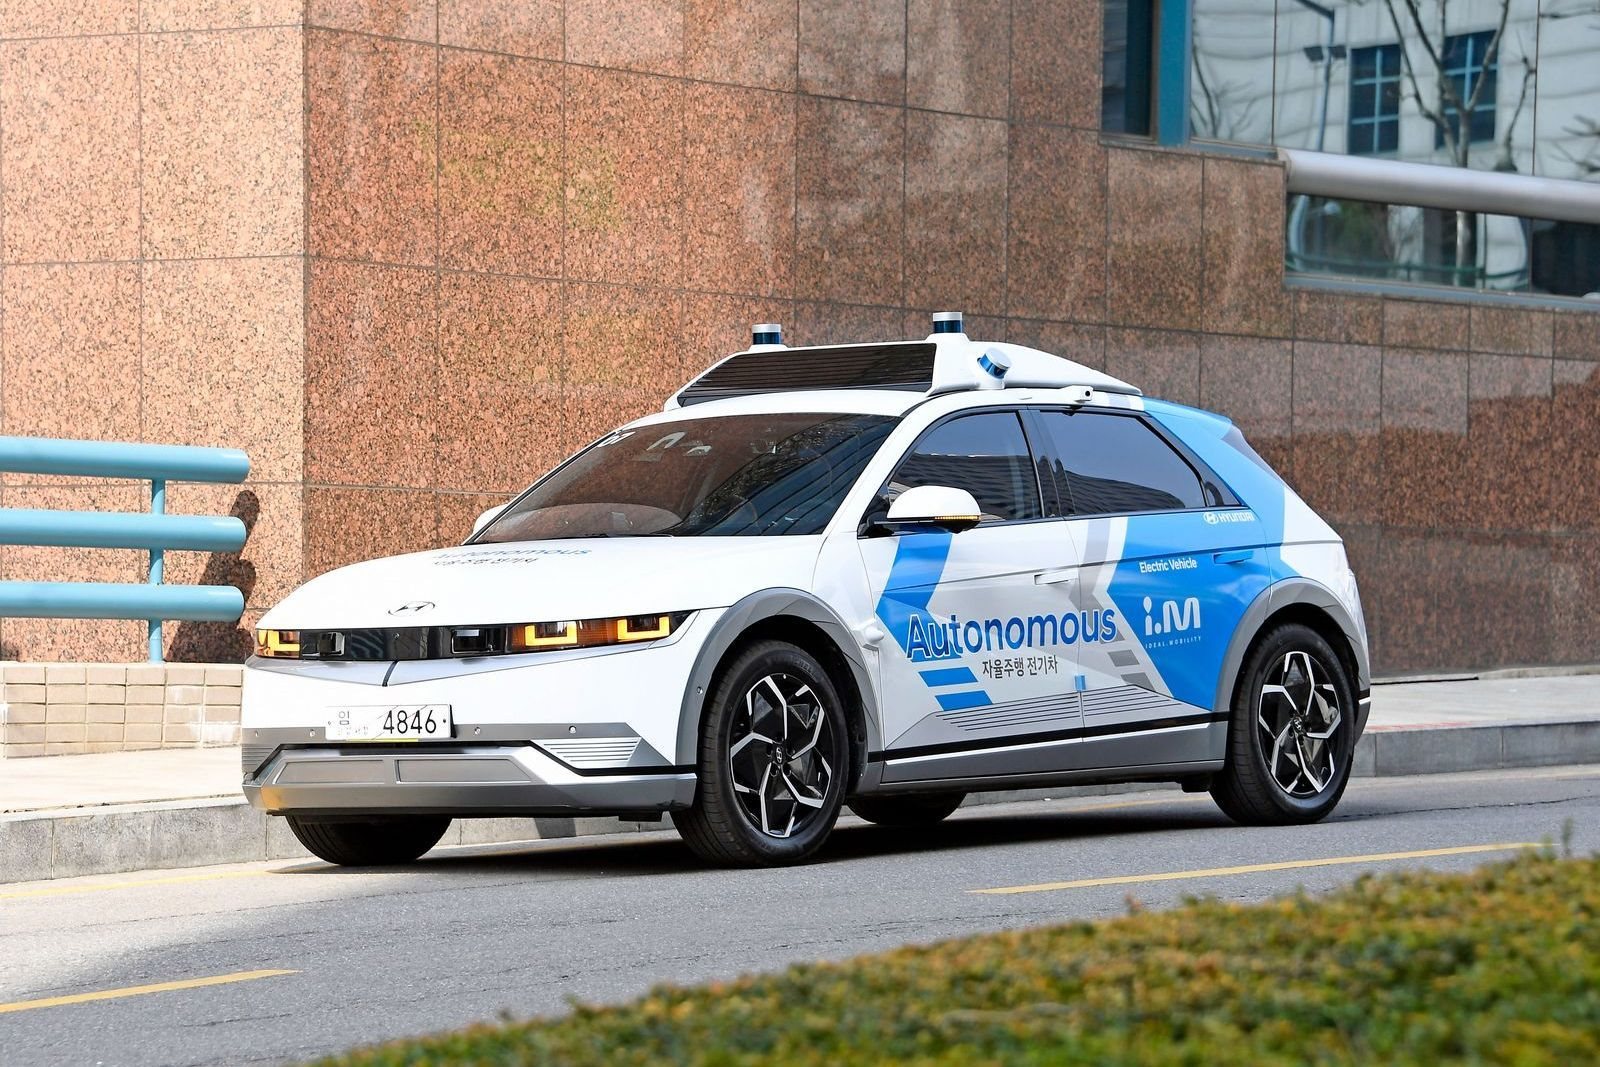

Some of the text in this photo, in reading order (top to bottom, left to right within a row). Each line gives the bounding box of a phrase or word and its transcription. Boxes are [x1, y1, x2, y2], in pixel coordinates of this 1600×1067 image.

[1218, 512, 1255, 522] HYUNDAI
[1139, 557, 1198, 573] Electric Vehicle
[906, 607, 1117, 660] Autonomous
[982, 654, 1058, 679] 자율주행 전기차
[383, 709, 437, 734] 4846
